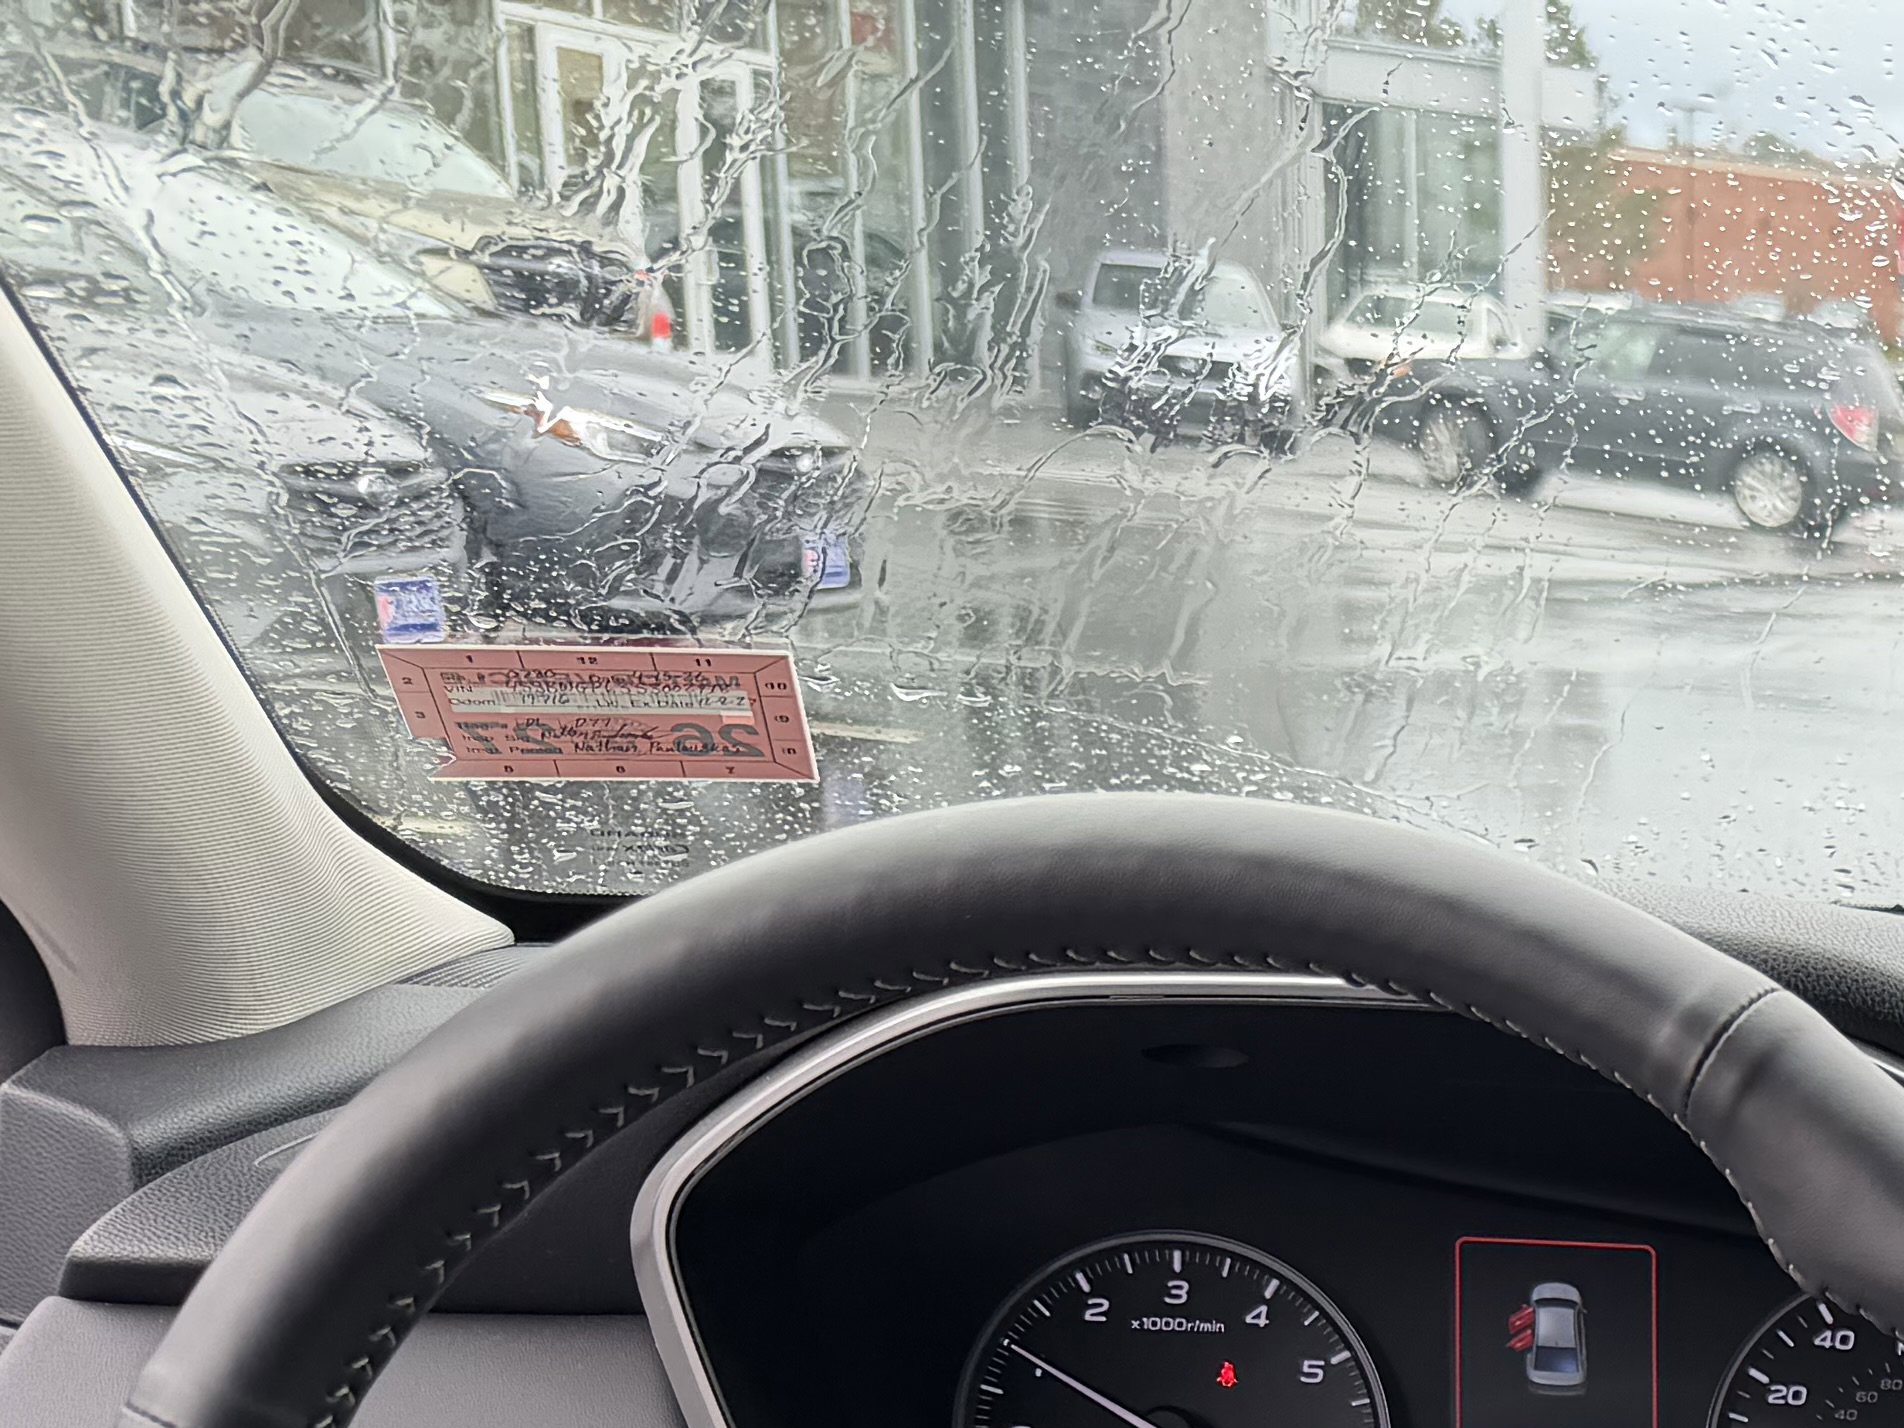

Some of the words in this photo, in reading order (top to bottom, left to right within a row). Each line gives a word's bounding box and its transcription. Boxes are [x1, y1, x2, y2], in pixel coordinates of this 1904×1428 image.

[1163, 1280, 1190, 1305] 3
[1083, 1299, 1110, 1323] 2
[1245, 1305, 1269, 1328] 4
[1813, 1330, 1856, 1351] 40
[1300, 1360, 1325, 1384] 5
[1880, 1379, 1903, 1390] 80
[1766, 1385, 1808, 1406] 20
[1855, 1391, 1878, 1403] 60
[1834, 1410, 1858, 1421] 40
